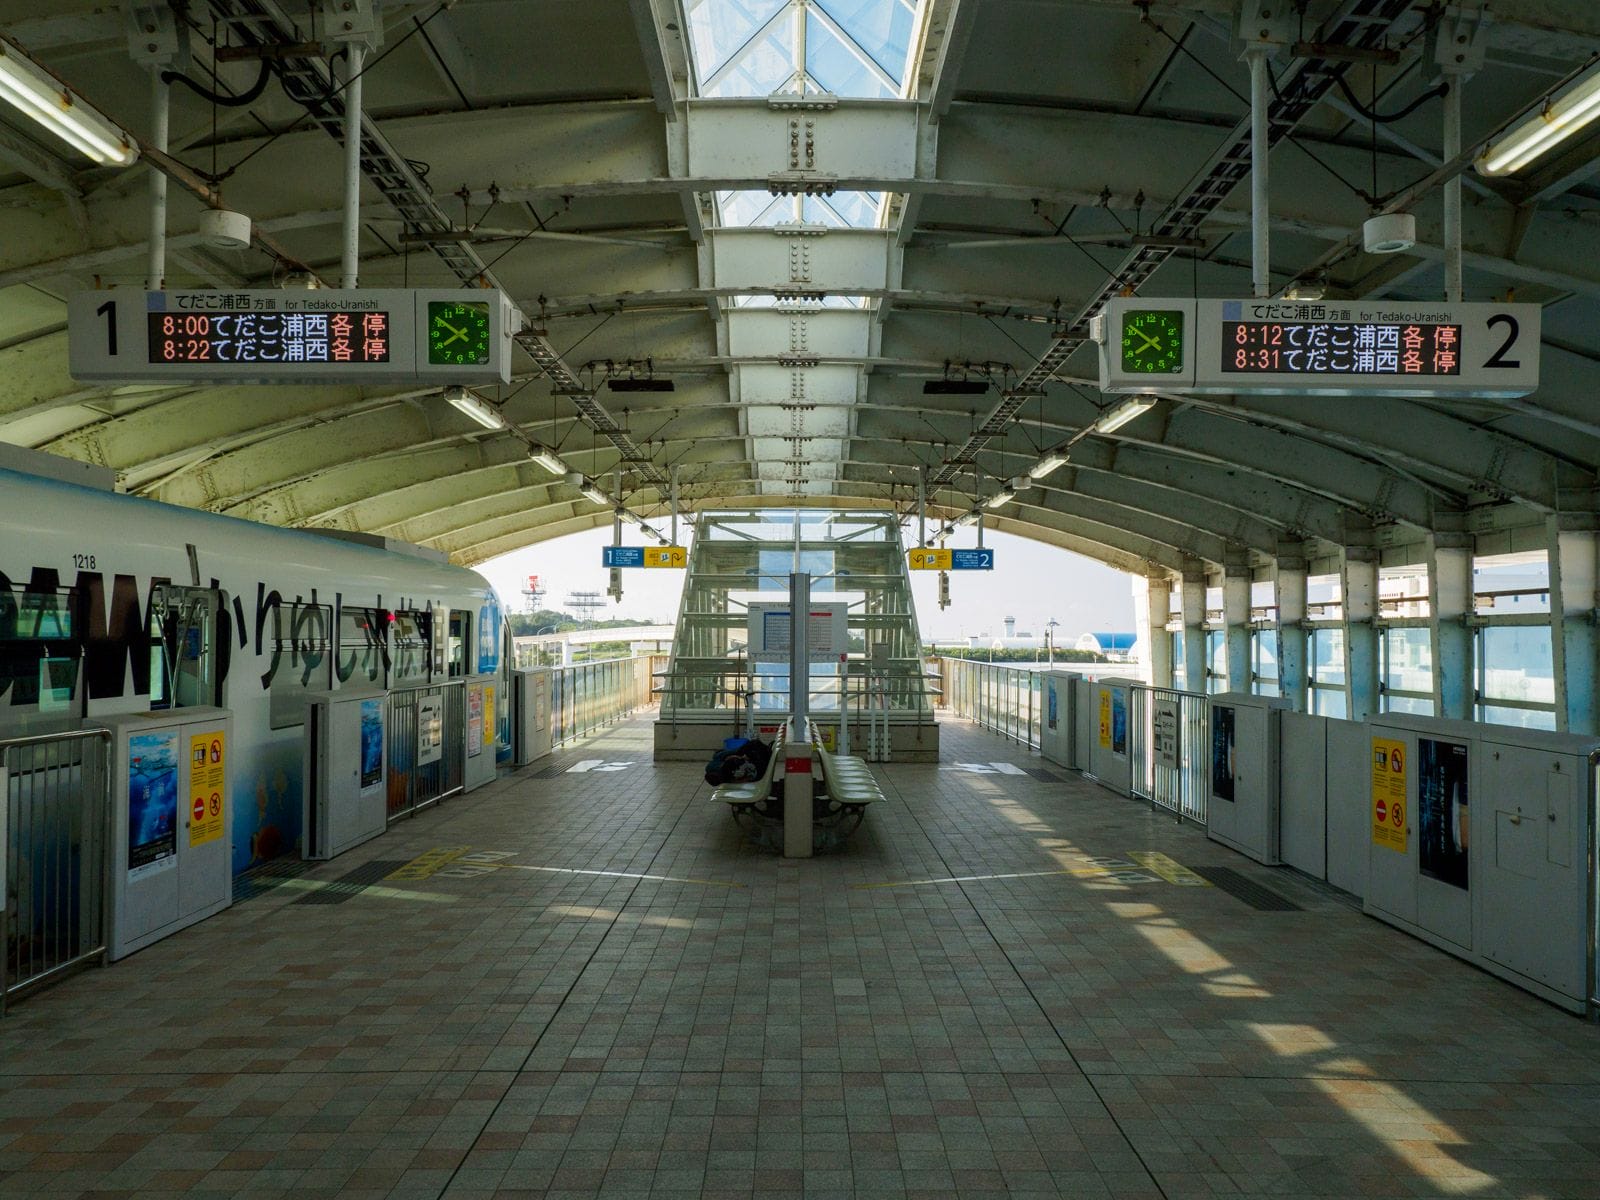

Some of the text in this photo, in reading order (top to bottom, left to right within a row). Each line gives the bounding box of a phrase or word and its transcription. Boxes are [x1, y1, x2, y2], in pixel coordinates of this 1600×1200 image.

[175, 294, 379, 310] てだこ浦西 方面 for Tedako-Uranishi
[1251, 304, 1452, 323] てだこ浦西 方面 for Tedako-Uranishi
[96, 301, 118, 356] 1
[163, 313, 386, 337] 8:00 てだこ浦西 各 停
[1235, 325, 1457, 350] 8:12 てだこ浦西 各 停
[1482, 314, 1521, 369] 2
[163, 338, 386, 361] 8:22 てだこ浦西 各 停
[1235, 349, 1457, 374] 8:31 てだこ浦西 各 停
[72, 553, 97, 570] 1218
[607, 550, 613, 564] 1
[980, 553, 990, 567] 2
